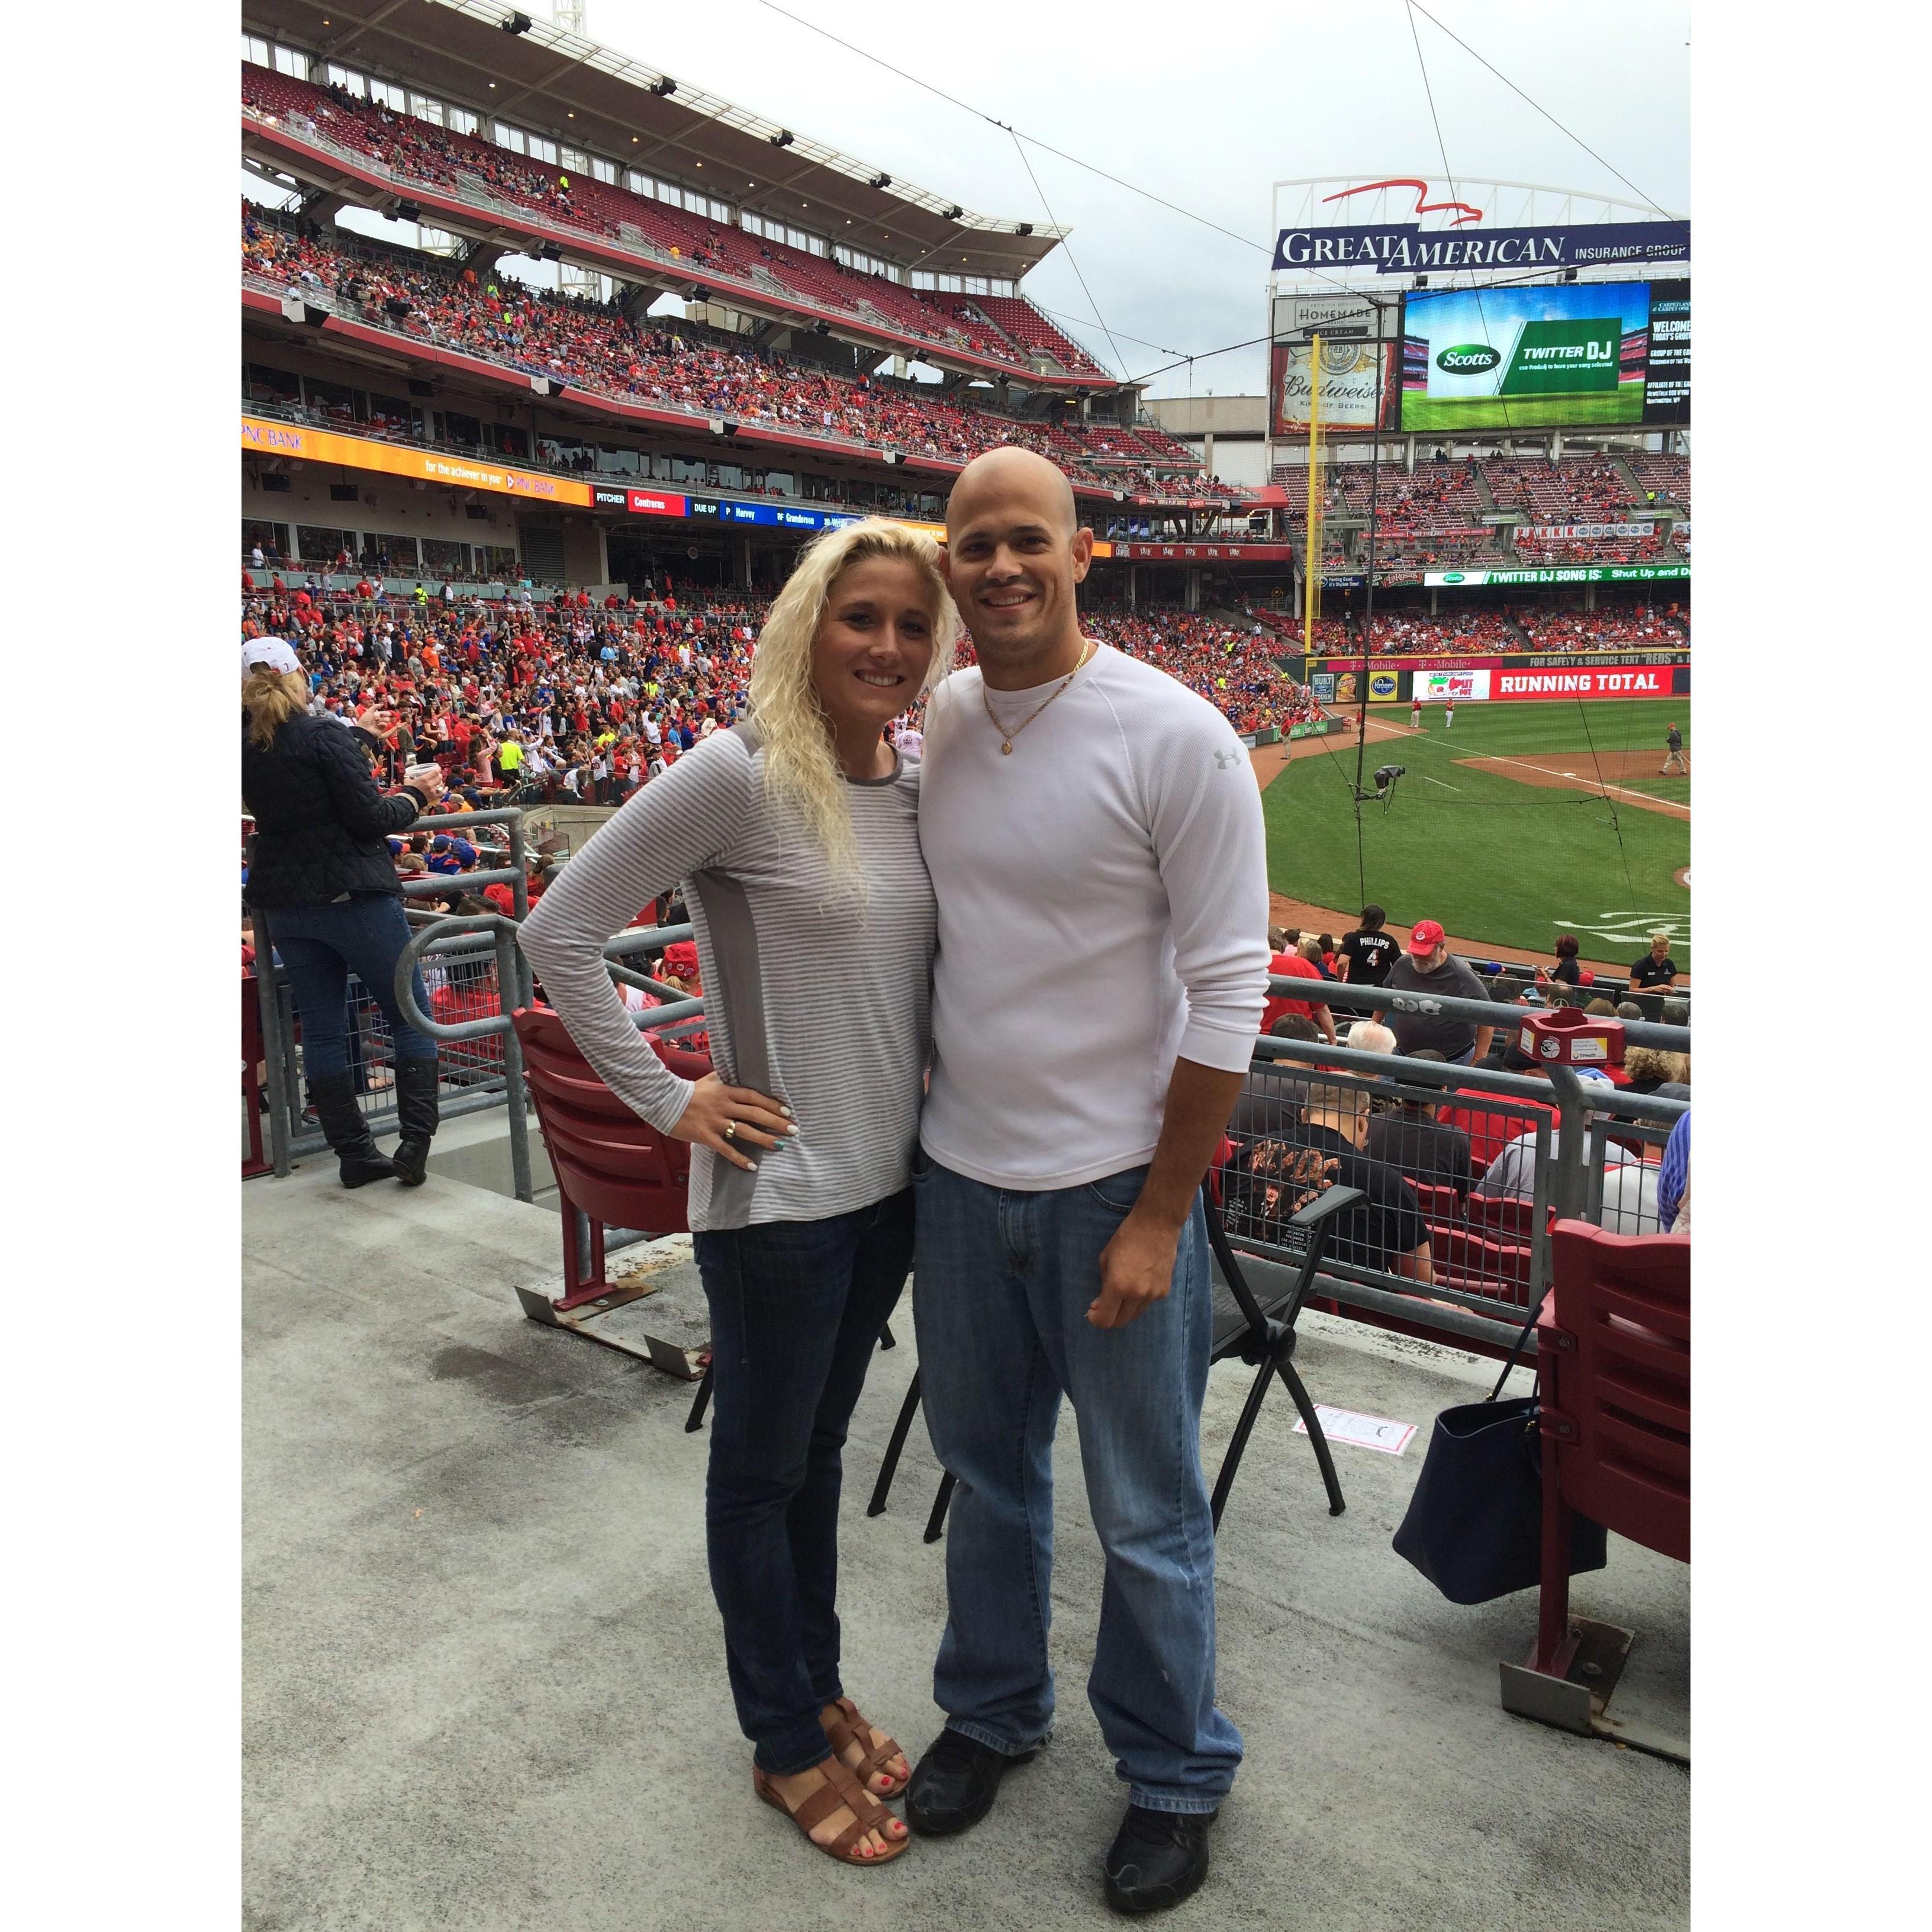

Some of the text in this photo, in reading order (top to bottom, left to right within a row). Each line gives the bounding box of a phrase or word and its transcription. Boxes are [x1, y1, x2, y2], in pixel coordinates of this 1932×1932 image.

[1282, 233, 1566, 266] GREAT AMERICAN
[1575, 244, 1686, 259] INSURANCE GROUP
[1299, 308, 1371, 320] HOMEMADE
[1653, 320, 1690, 333] WELCOME
[1523, 341, 1612, 360] TWITTER DJ
[1443, 351, 1493, 367] Scotts
[268, 429, 303, 450] BANK
[426, 459, 501, 485] for the achiever in you
[516, 477, 555, 495] PNC BANK
[597, 492, 625, 504] PITCHER
[634, 496, 665, 510] Contreras
[694, 503, 716, 514] DUE UP
[726, 507, 730, 516] P
[736, 507, 755, 520] Harvey
[785, 513, 814, 525] Granderson
[1554, 526, 1561, 537] K
[1567, 526, 1574, 537] K
[1491, 571, 1538, 583] TWITTER
[1540, 571, 1554, 582] DJ
[1556, 569, 1586, 581] SONG
[1589, 569, 1602, 581] IS:
[1611, 569, 1637, 578] Shut
[1640, 568, 1655, 578] Up
[1657, 568, 1678, 577] and
[1530, 657, 1545, 666] FOR
[1547, 656, 1576, 666] SAFETY
[1577, 657, 1583, 665] &
[1585, 655, 1618, 665] SERVICE
[1621, 655, 1640, 664] TEXT
[1677, 655, 1683, 664] &
[1374, 679, 1394, 693] Kroger
[1500, 673, 1660, 693] RUNNING TOTAL
[1360, 936, 1390, 949] PHILLIPS
[1367, 949, 1379, 966] 4
